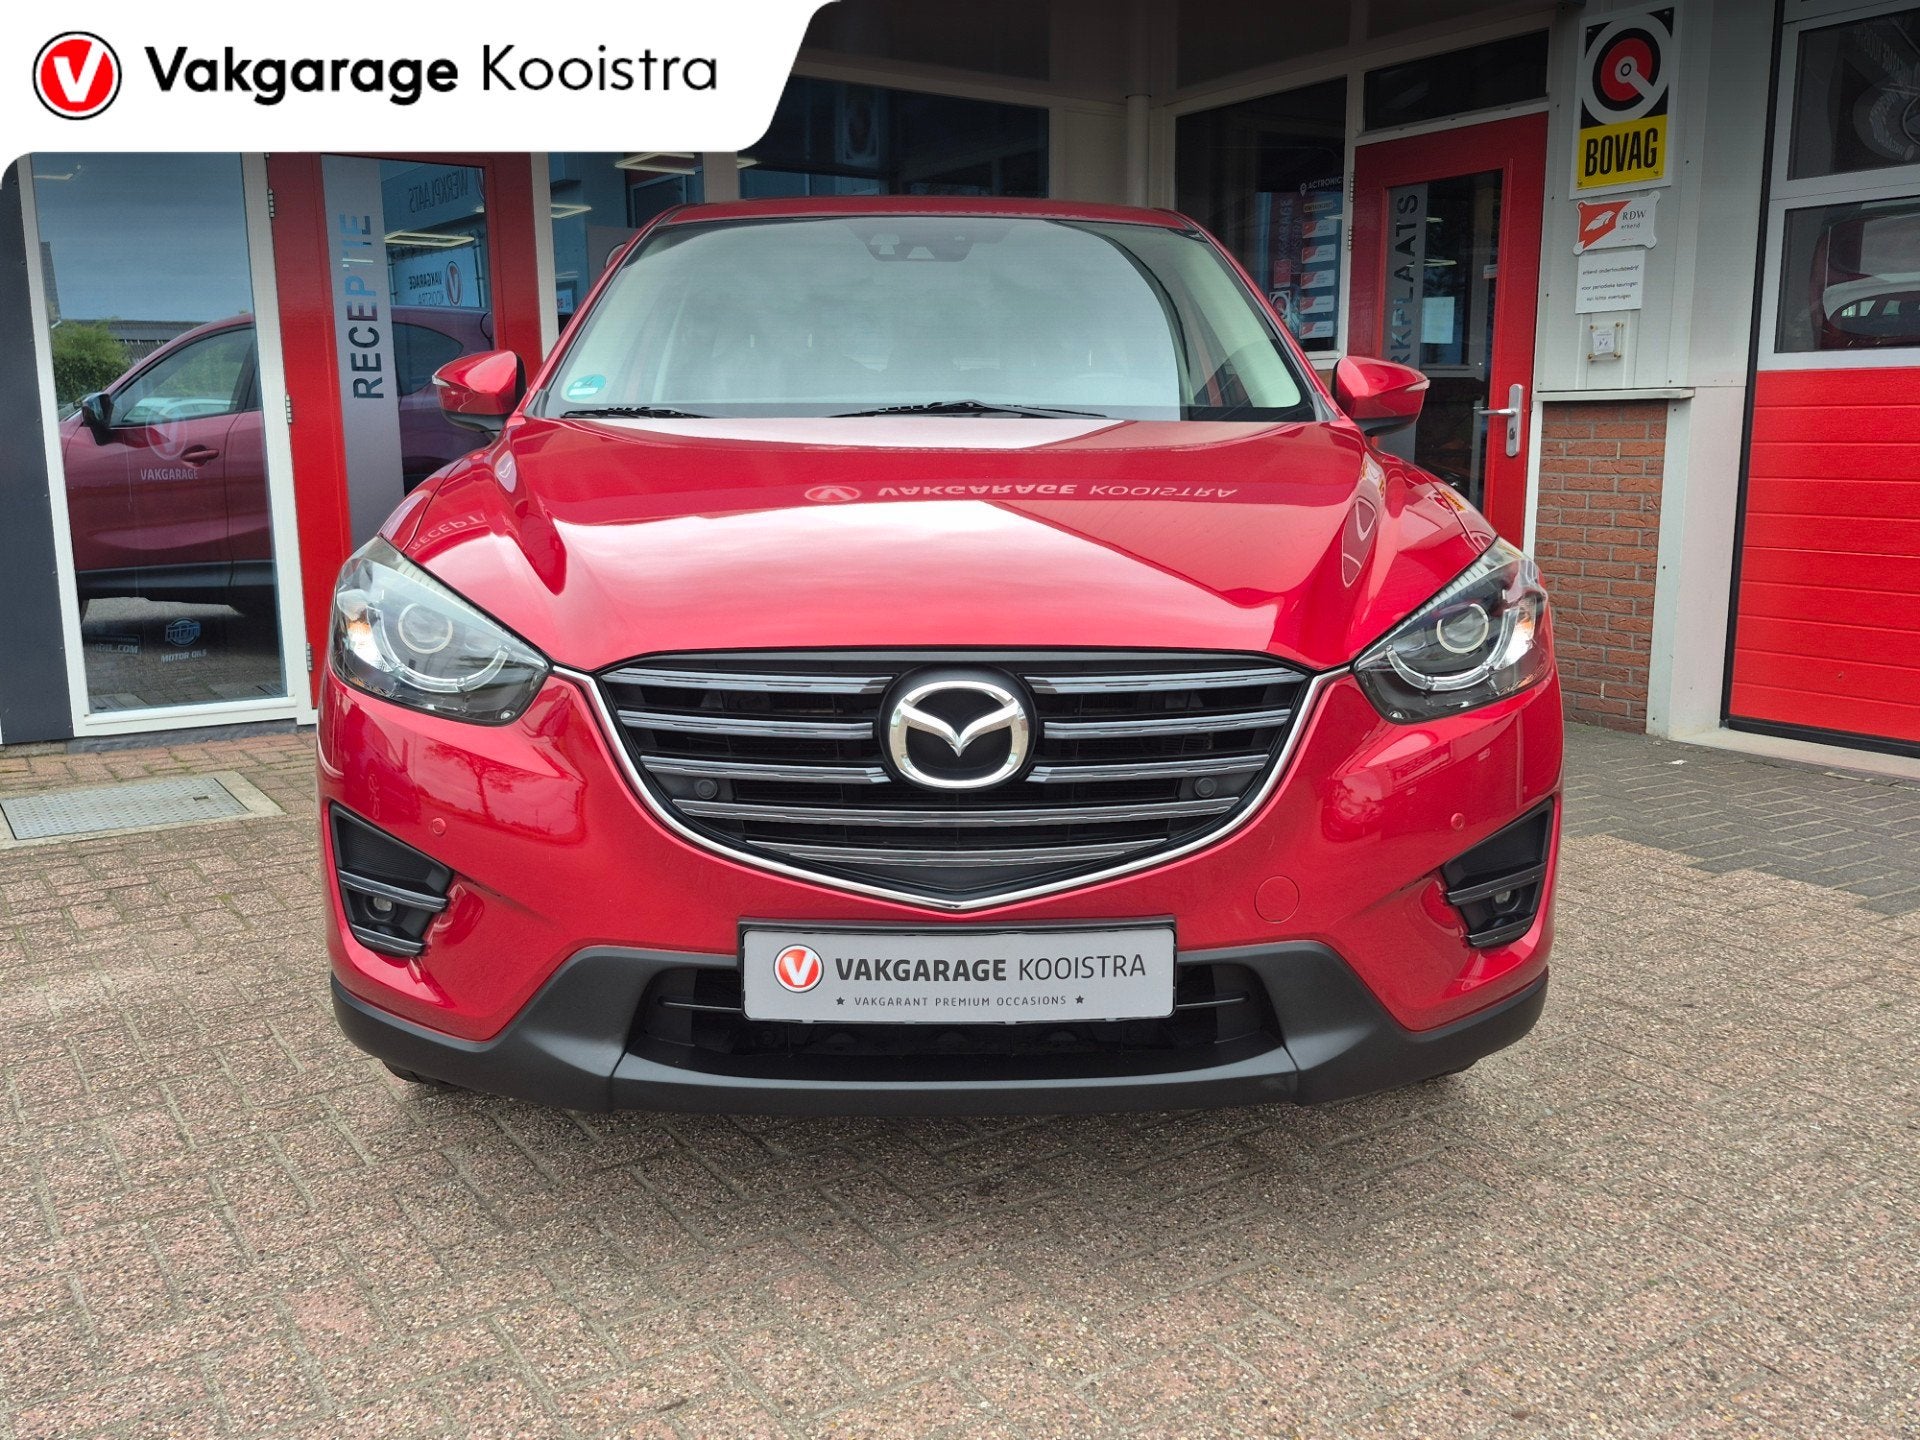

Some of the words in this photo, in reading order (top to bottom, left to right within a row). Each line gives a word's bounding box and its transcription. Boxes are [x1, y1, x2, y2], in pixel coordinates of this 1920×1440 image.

[1584, 127, 1659, 178] BOVAG
[1308, 176, 1344, 190] ACTRONIC
[1622, 209, 1648, 221] RDW
[1621, 222, 1641, 230] erkend
[339, 213, 384, 399] RECEPTIE
[140, 467, 199, 482] VAKGARAGE
[160, 651, 190, 663] MOTOR
[191, 648, 207, 660] OILS
[835, 957, 1008, 983] VAKGARAGE
[1018, 953, 1146, 981] KOOISTRA
[854, 996, 928, 1007] VAKGARANT
[935, 996, 990, 1007] PREMIUM
[996, 995, 1067, 1006] OCCASIONS
